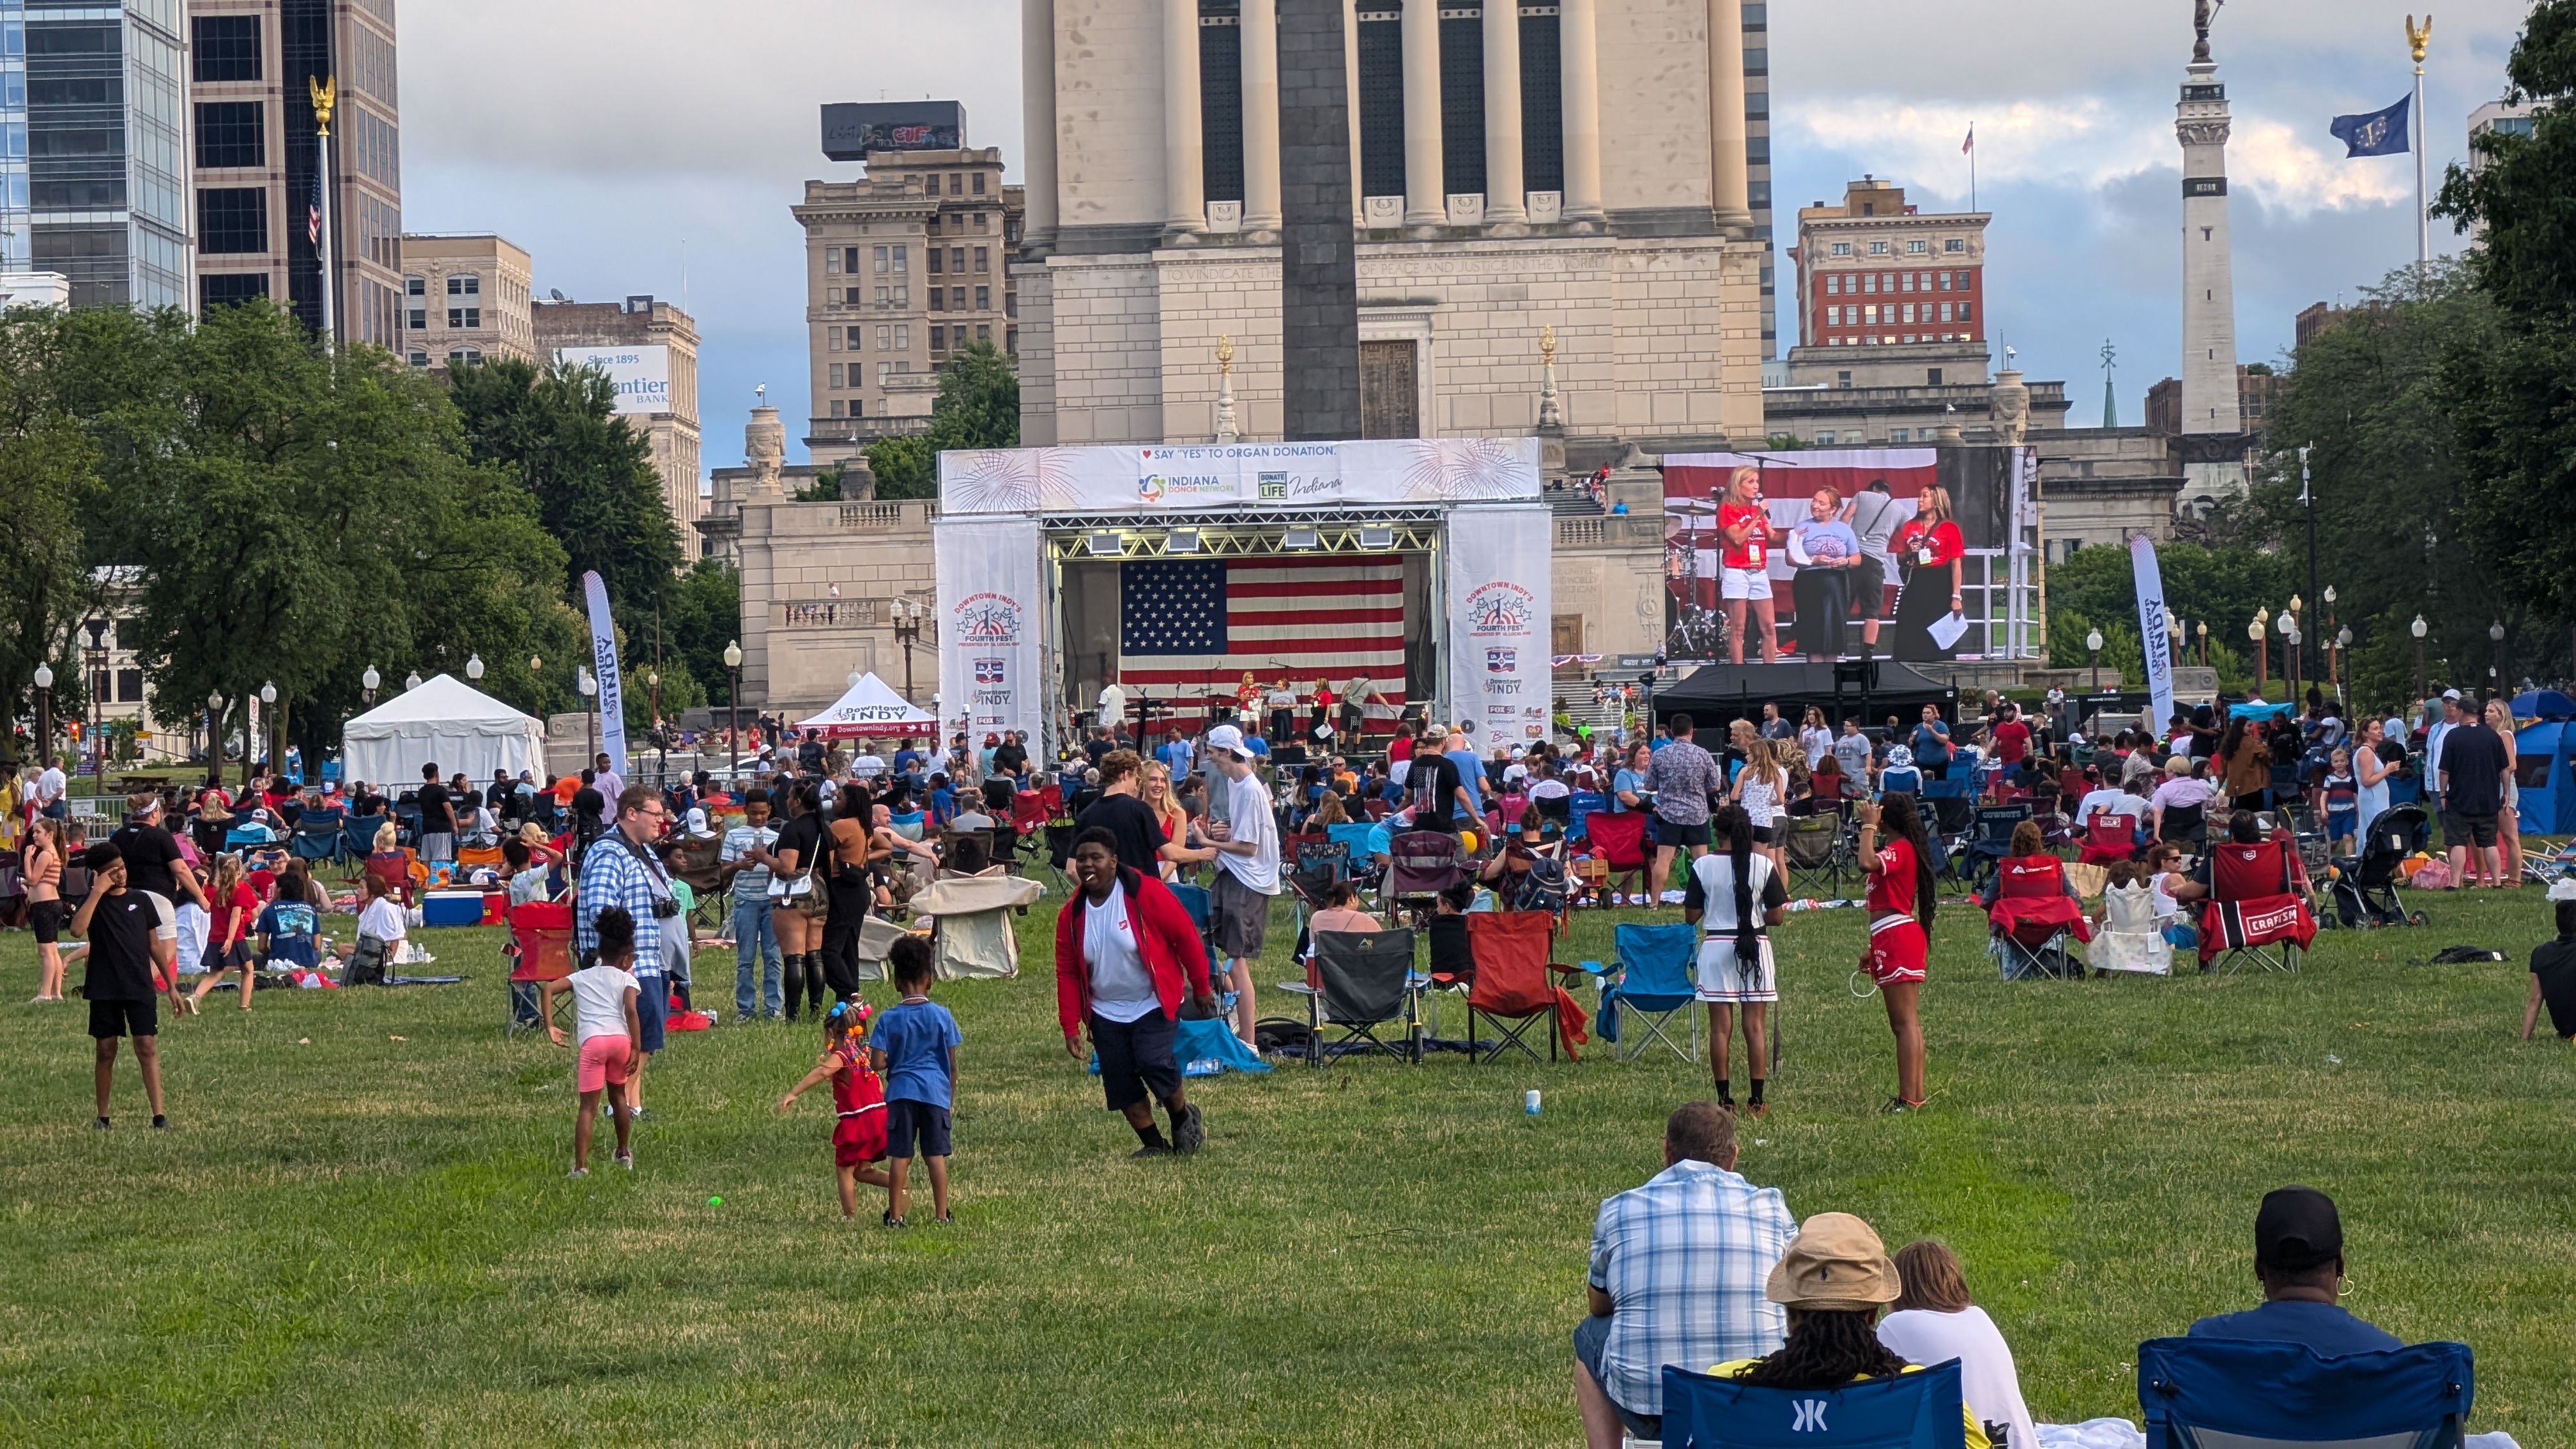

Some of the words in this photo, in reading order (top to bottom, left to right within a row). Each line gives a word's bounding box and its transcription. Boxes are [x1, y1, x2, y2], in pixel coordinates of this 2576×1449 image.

[1360, 264, 1376, 275] OF
[1381, 263, 1420, 274] PEACE
[1425, 261, 1454, 273] AND
[1458, 259, 1508, 272] JUSTICE
[1512, 258, 1525, 270] IN
[1530, 258, 1554, 270] THE
[1558, 256, 1605, 269] WORLD
[1165, 270, 1182, 280] TO
[1186, 268, 1254, 280] VINDICATE
[1259, 267, 1282, 279] THE
[615, 355, 640, 364] 1895
[637, 395, 670, 403] BANK
[1154, 450, 1174, 459] SAY
[1177, 449, 1206, 459] "YES"
[1209, 449, 1223, 458] TO
[1227, 448, 1269, 457] ORGAN
[1273, 447, 1337, 456] DONATION.
[1169, 475, 1219, 486] INDIANA
[1289, 475, 1343, 496] Indiana
[1261, 486, 1285, 497] LIFE
[1466, 581, 1509, 604] DOWNTOWN
[1511, 584, 1534, 602] INDY'S
[954, 592, 997, 614] DOWNTOWN
[999, 594, 1022, 613] INDY'S
[2144, 598, 2158, 669] Downtown
[2150, 599, 2166, 659] INDY
[602, 637, 617, 698] INDY
[1493, 684, 1521, 694] INDY
[981, 696, 1010, 705] INDY
[847, 705, 907, 714] Downtown
[851, 711, 907, 721] INDY
[804, 729, 829, 737] IDY
[838, 724, 900, 733] DowntownIndy.org
[1982, 810, 2021, 818] COWBOYS
